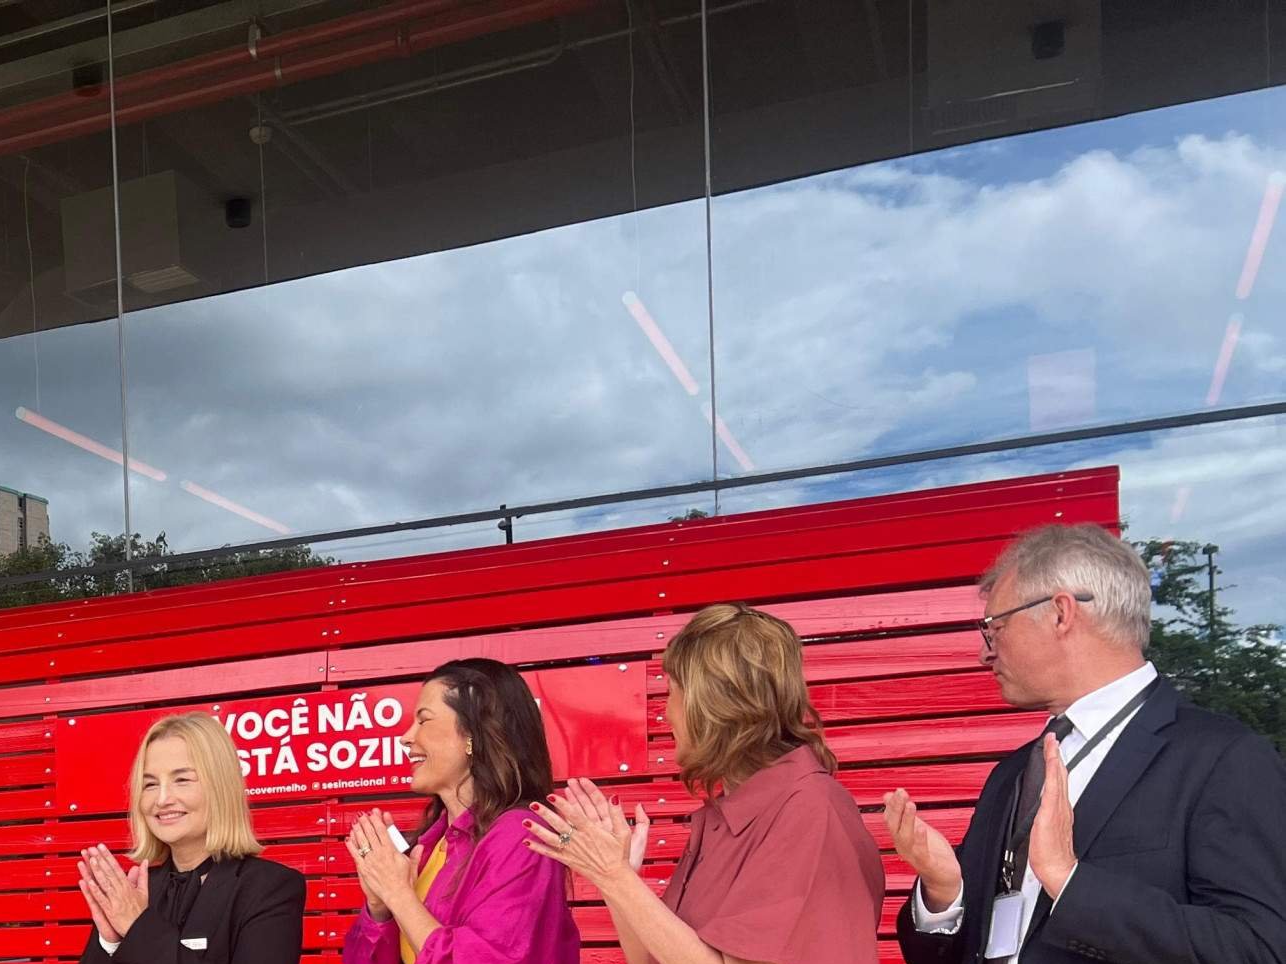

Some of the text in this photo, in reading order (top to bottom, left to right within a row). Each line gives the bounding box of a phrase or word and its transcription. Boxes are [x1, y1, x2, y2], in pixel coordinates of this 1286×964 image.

[212, 692, 403, 740] VOCÊ NÃO
[236, 736, 411, 777] STÁ SOZIN
[245, 784, 307, 795] ncovermelho
[322, 777, 386, 790] sesinacional
